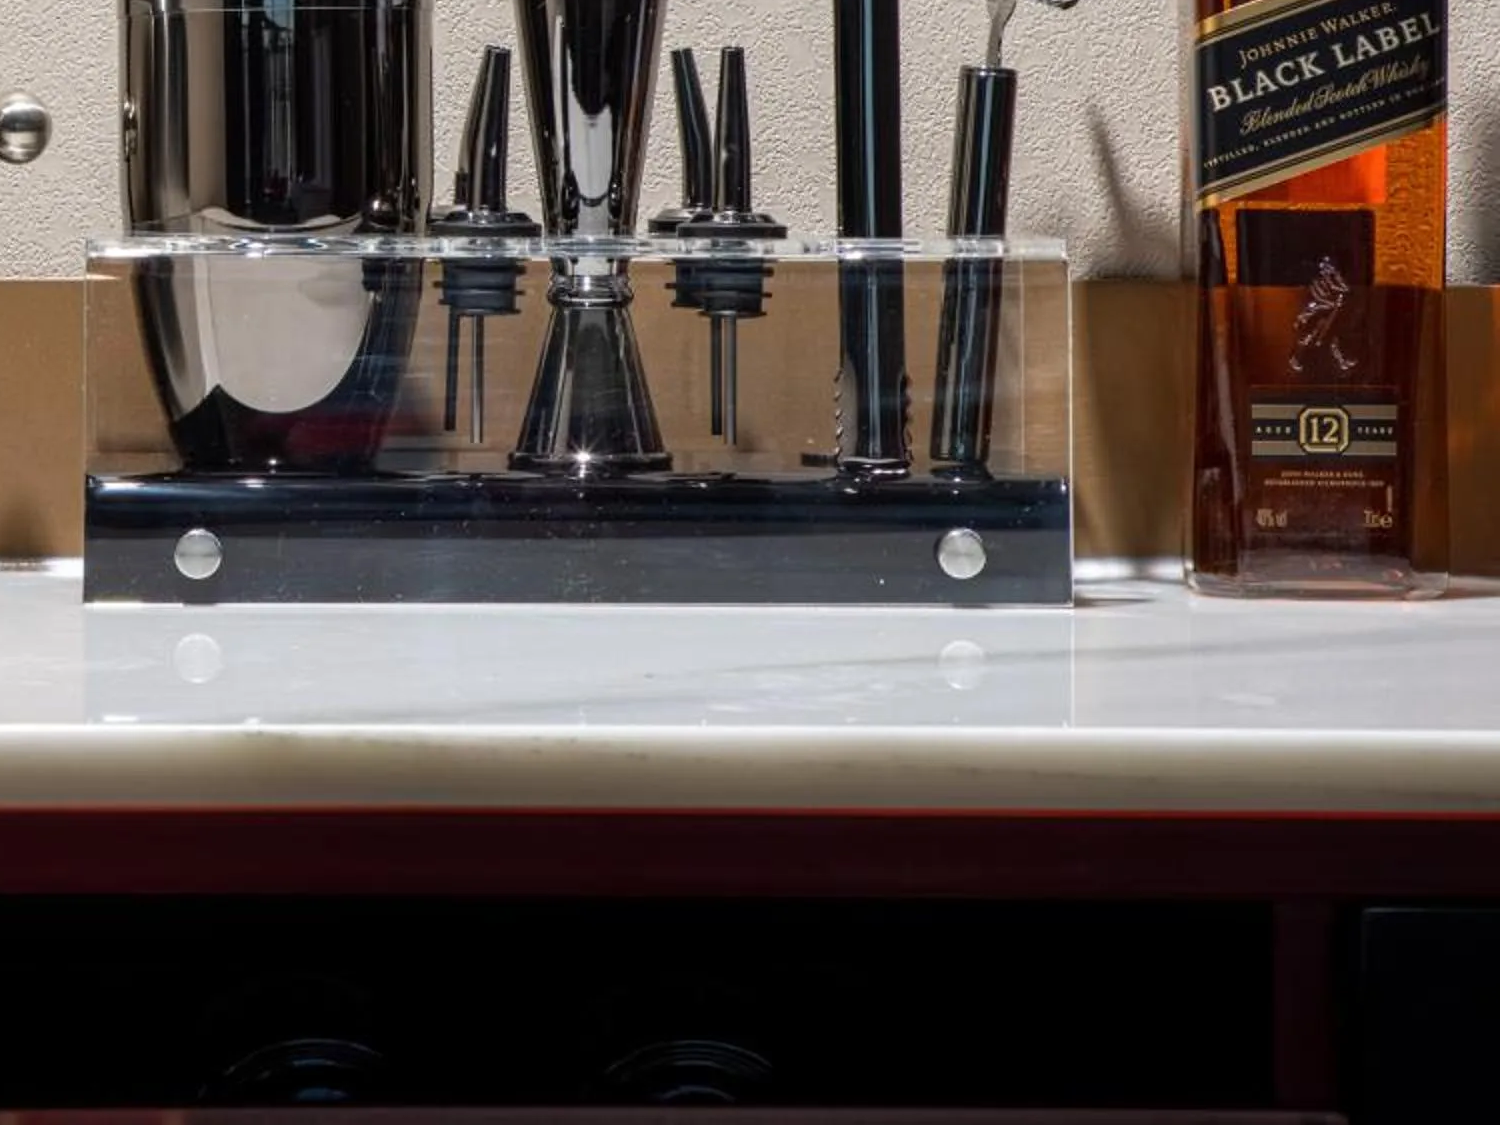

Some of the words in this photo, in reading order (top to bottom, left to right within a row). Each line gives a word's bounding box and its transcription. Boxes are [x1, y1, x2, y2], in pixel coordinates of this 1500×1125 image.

[1206, 50, 1326, 113] BLACK
[1330, 11, 1441, 69] LABEL
[1238, 26, 1319, 70] JOHNNIE
[1239, 90, 1315, 135] Blended
[1313, 78, 1368, 111] Scotch
[1310, 416, 1339, 443] 12
